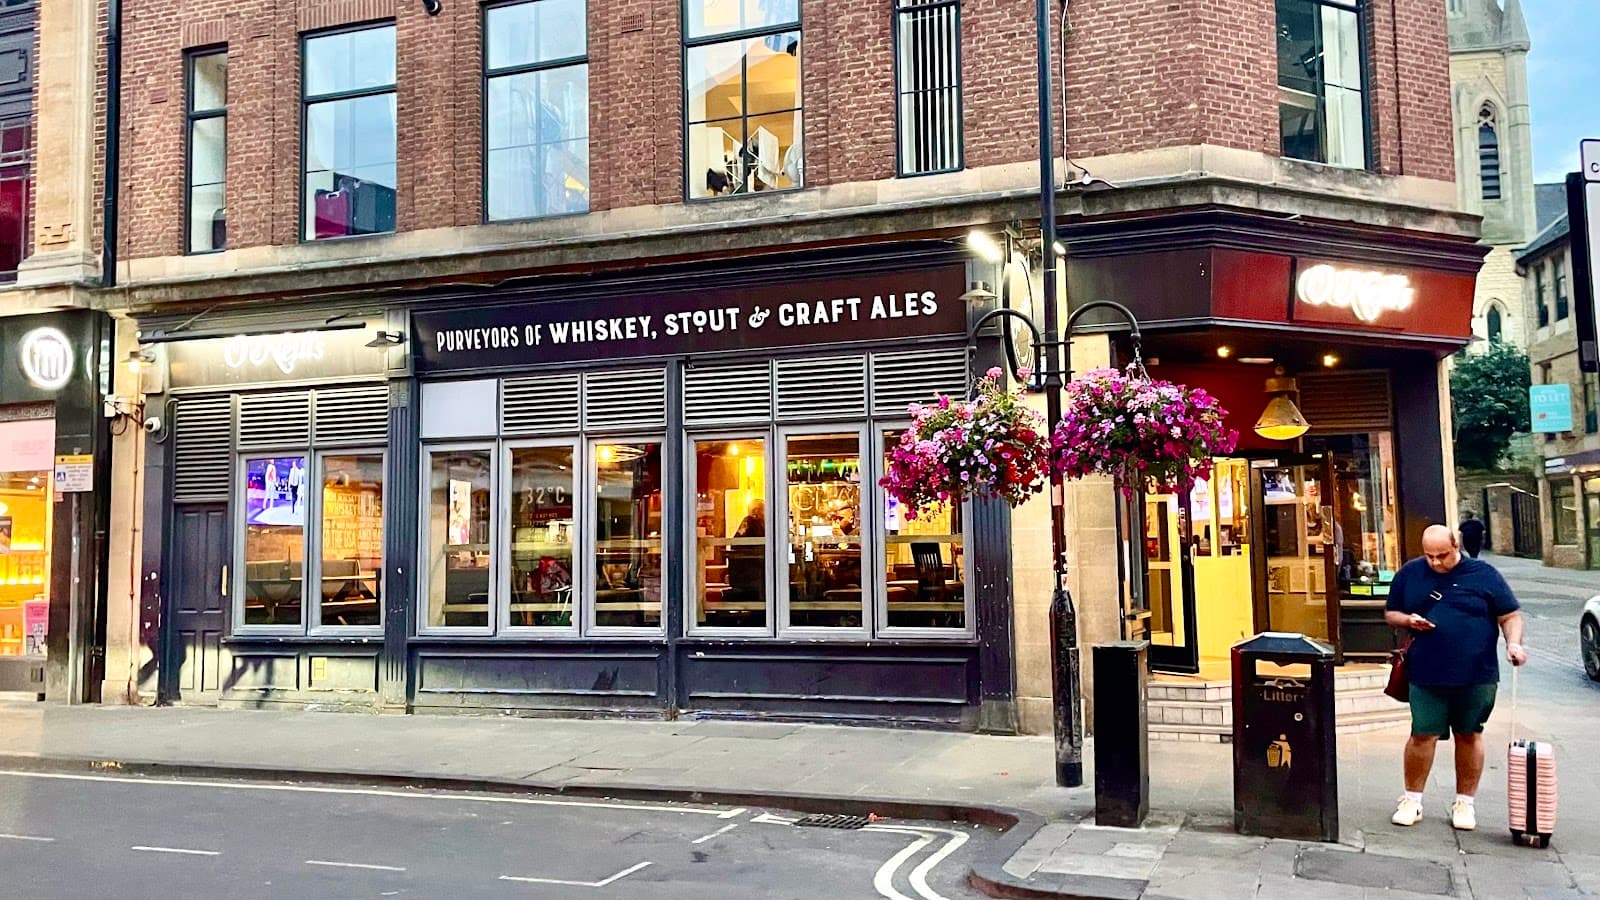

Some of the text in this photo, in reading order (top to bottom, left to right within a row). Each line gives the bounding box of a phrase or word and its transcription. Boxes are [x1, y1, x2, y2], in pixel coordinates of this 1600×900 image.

[436, 291, 938, 352] PURVEYORS OF WHISKEY, STOUT & CRAFT ALES
[1263, 690, 1297, 702] Litter
